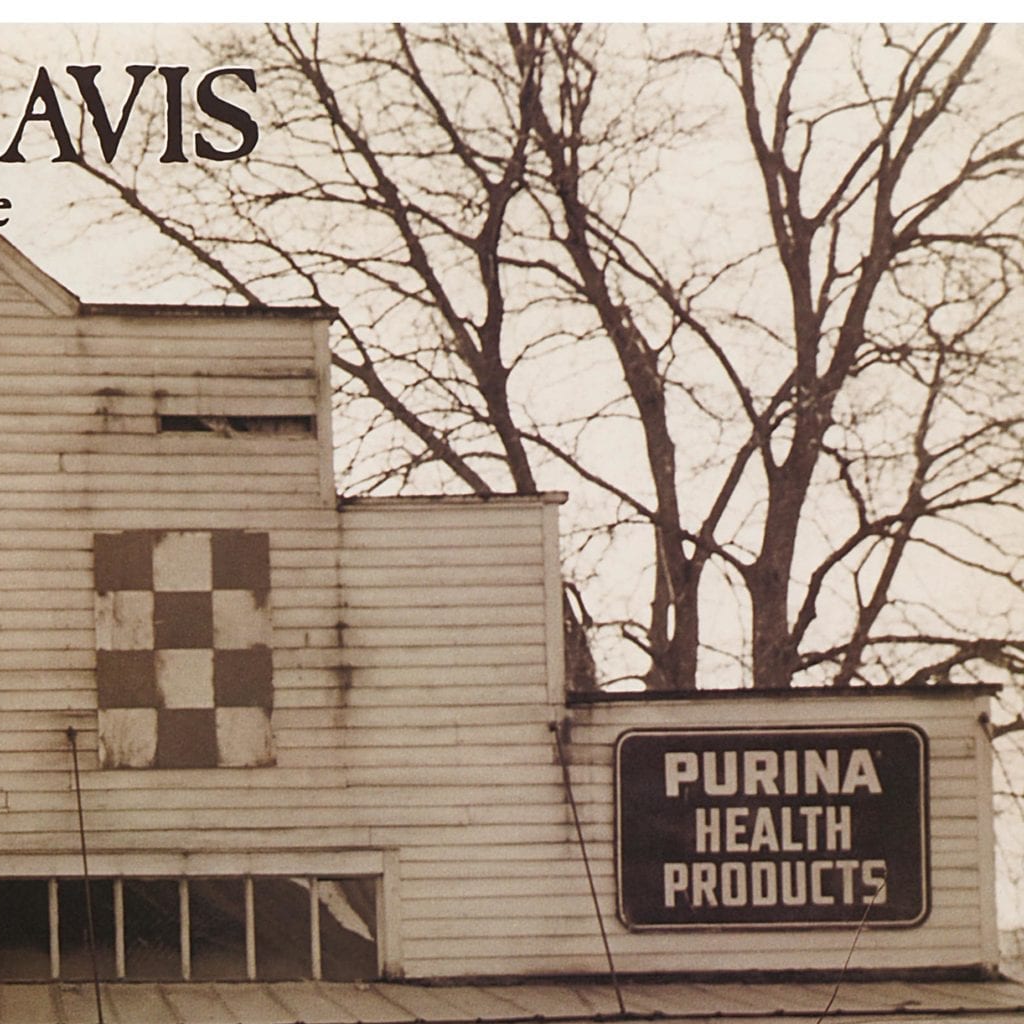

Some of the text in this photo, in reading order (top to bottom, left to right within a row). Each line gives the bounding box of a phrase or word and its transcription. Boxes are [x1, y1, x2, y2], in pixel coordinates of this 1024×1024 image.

[664, 748, 883, 798] PURINA
[694, 805, 852, 854] HEALTH
[663, 859, 888, 909] PRODUCTS
